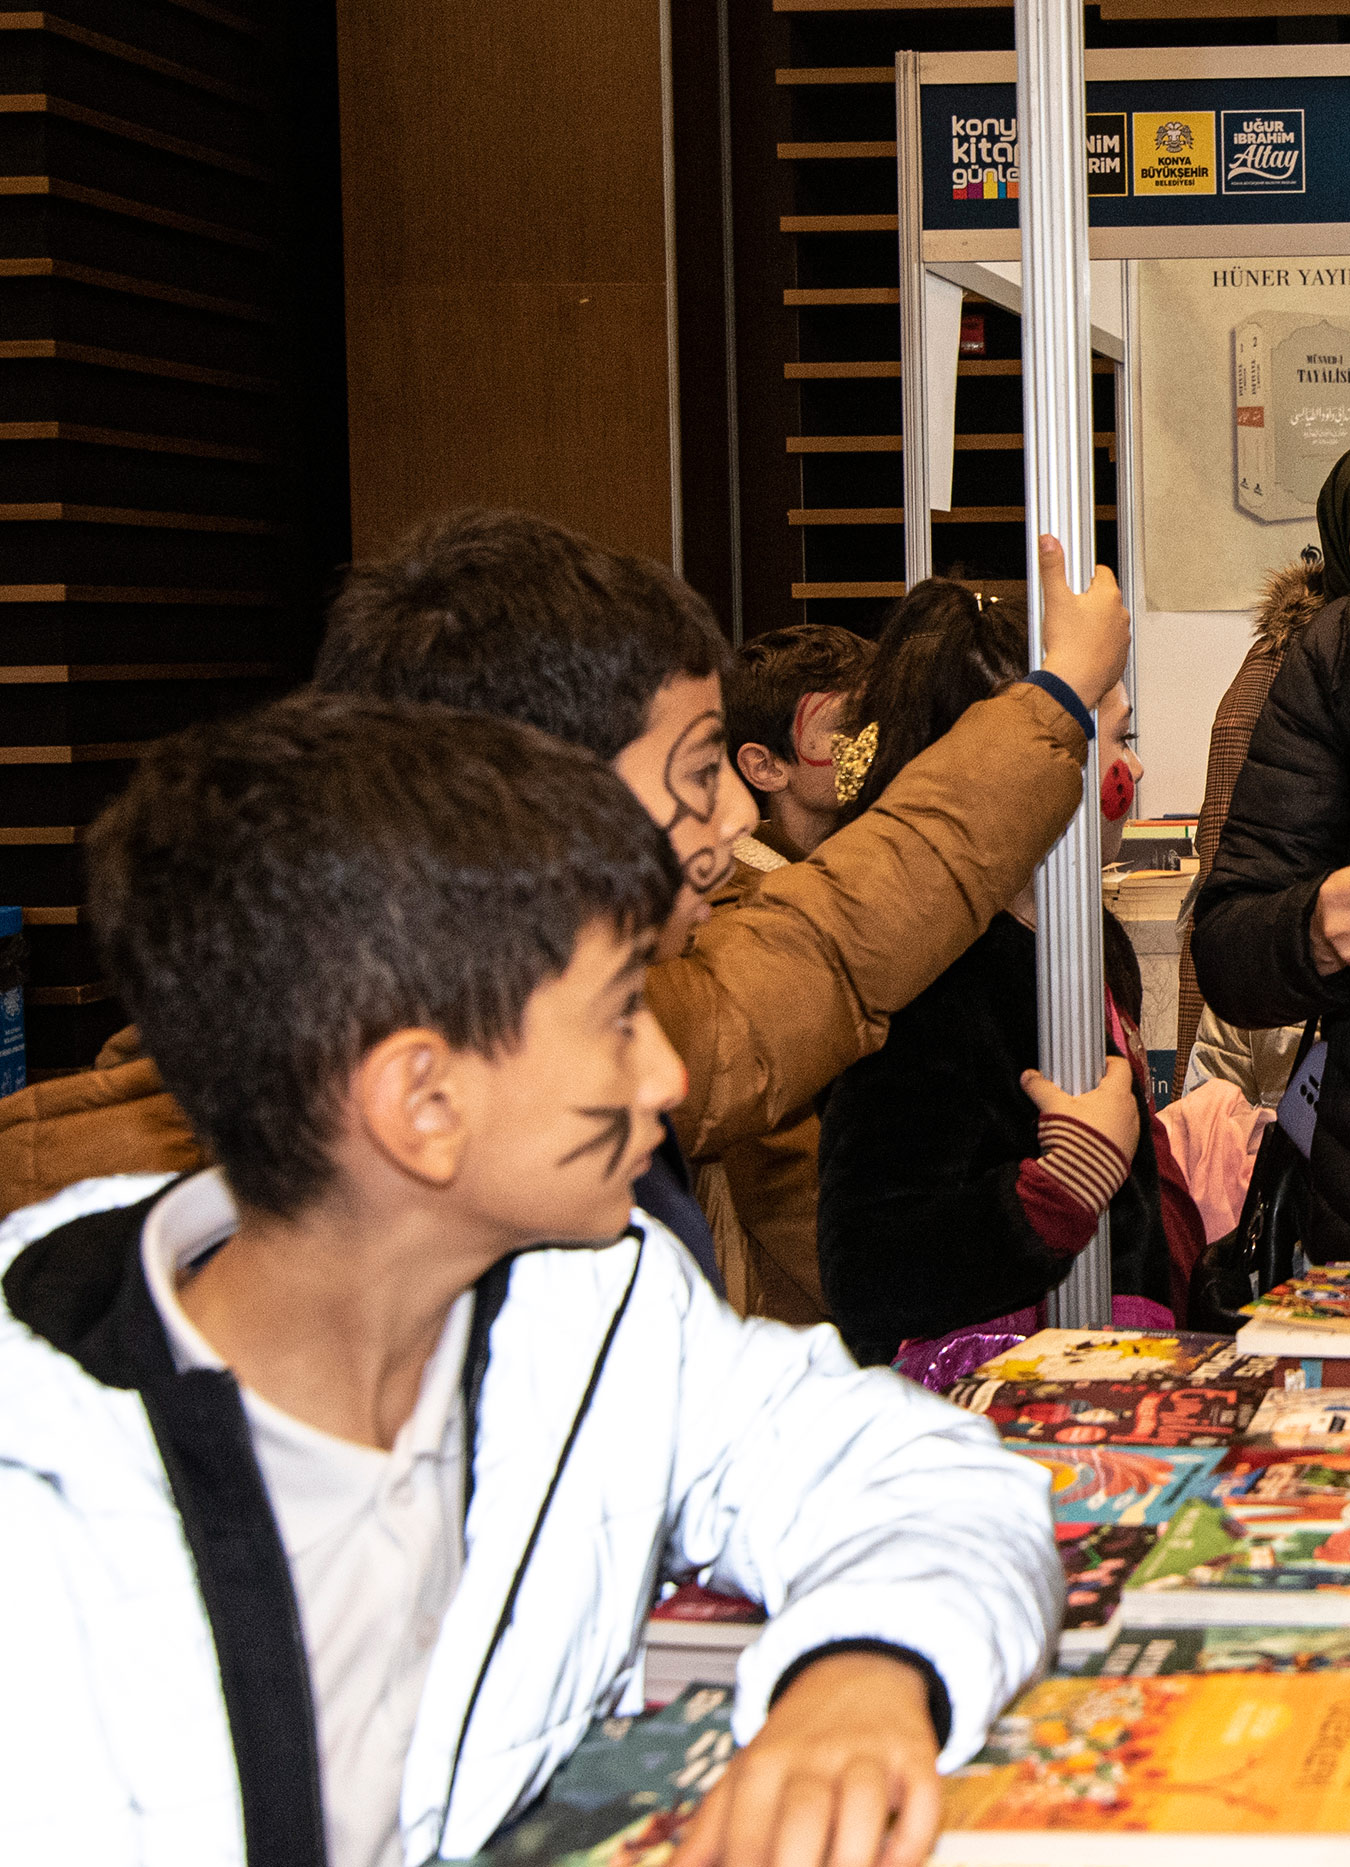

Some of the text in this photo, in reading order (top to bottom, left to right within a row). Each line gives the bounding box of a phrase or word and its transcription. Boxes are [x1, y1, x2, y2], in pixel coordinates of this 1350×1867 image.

[952, 115, 1017, 141] kony
[1243, 118, 1284, 133] UĞUR
[1158, 157, 1191, 166] KONYA
[1228, 145, 1299, 180] Altay
[952, 164, 1019, 189] günle
[1141, 166, 1208, 180] BÜYÜKŞEHİR
[1213, 267, 1289, 287] HÜNER
